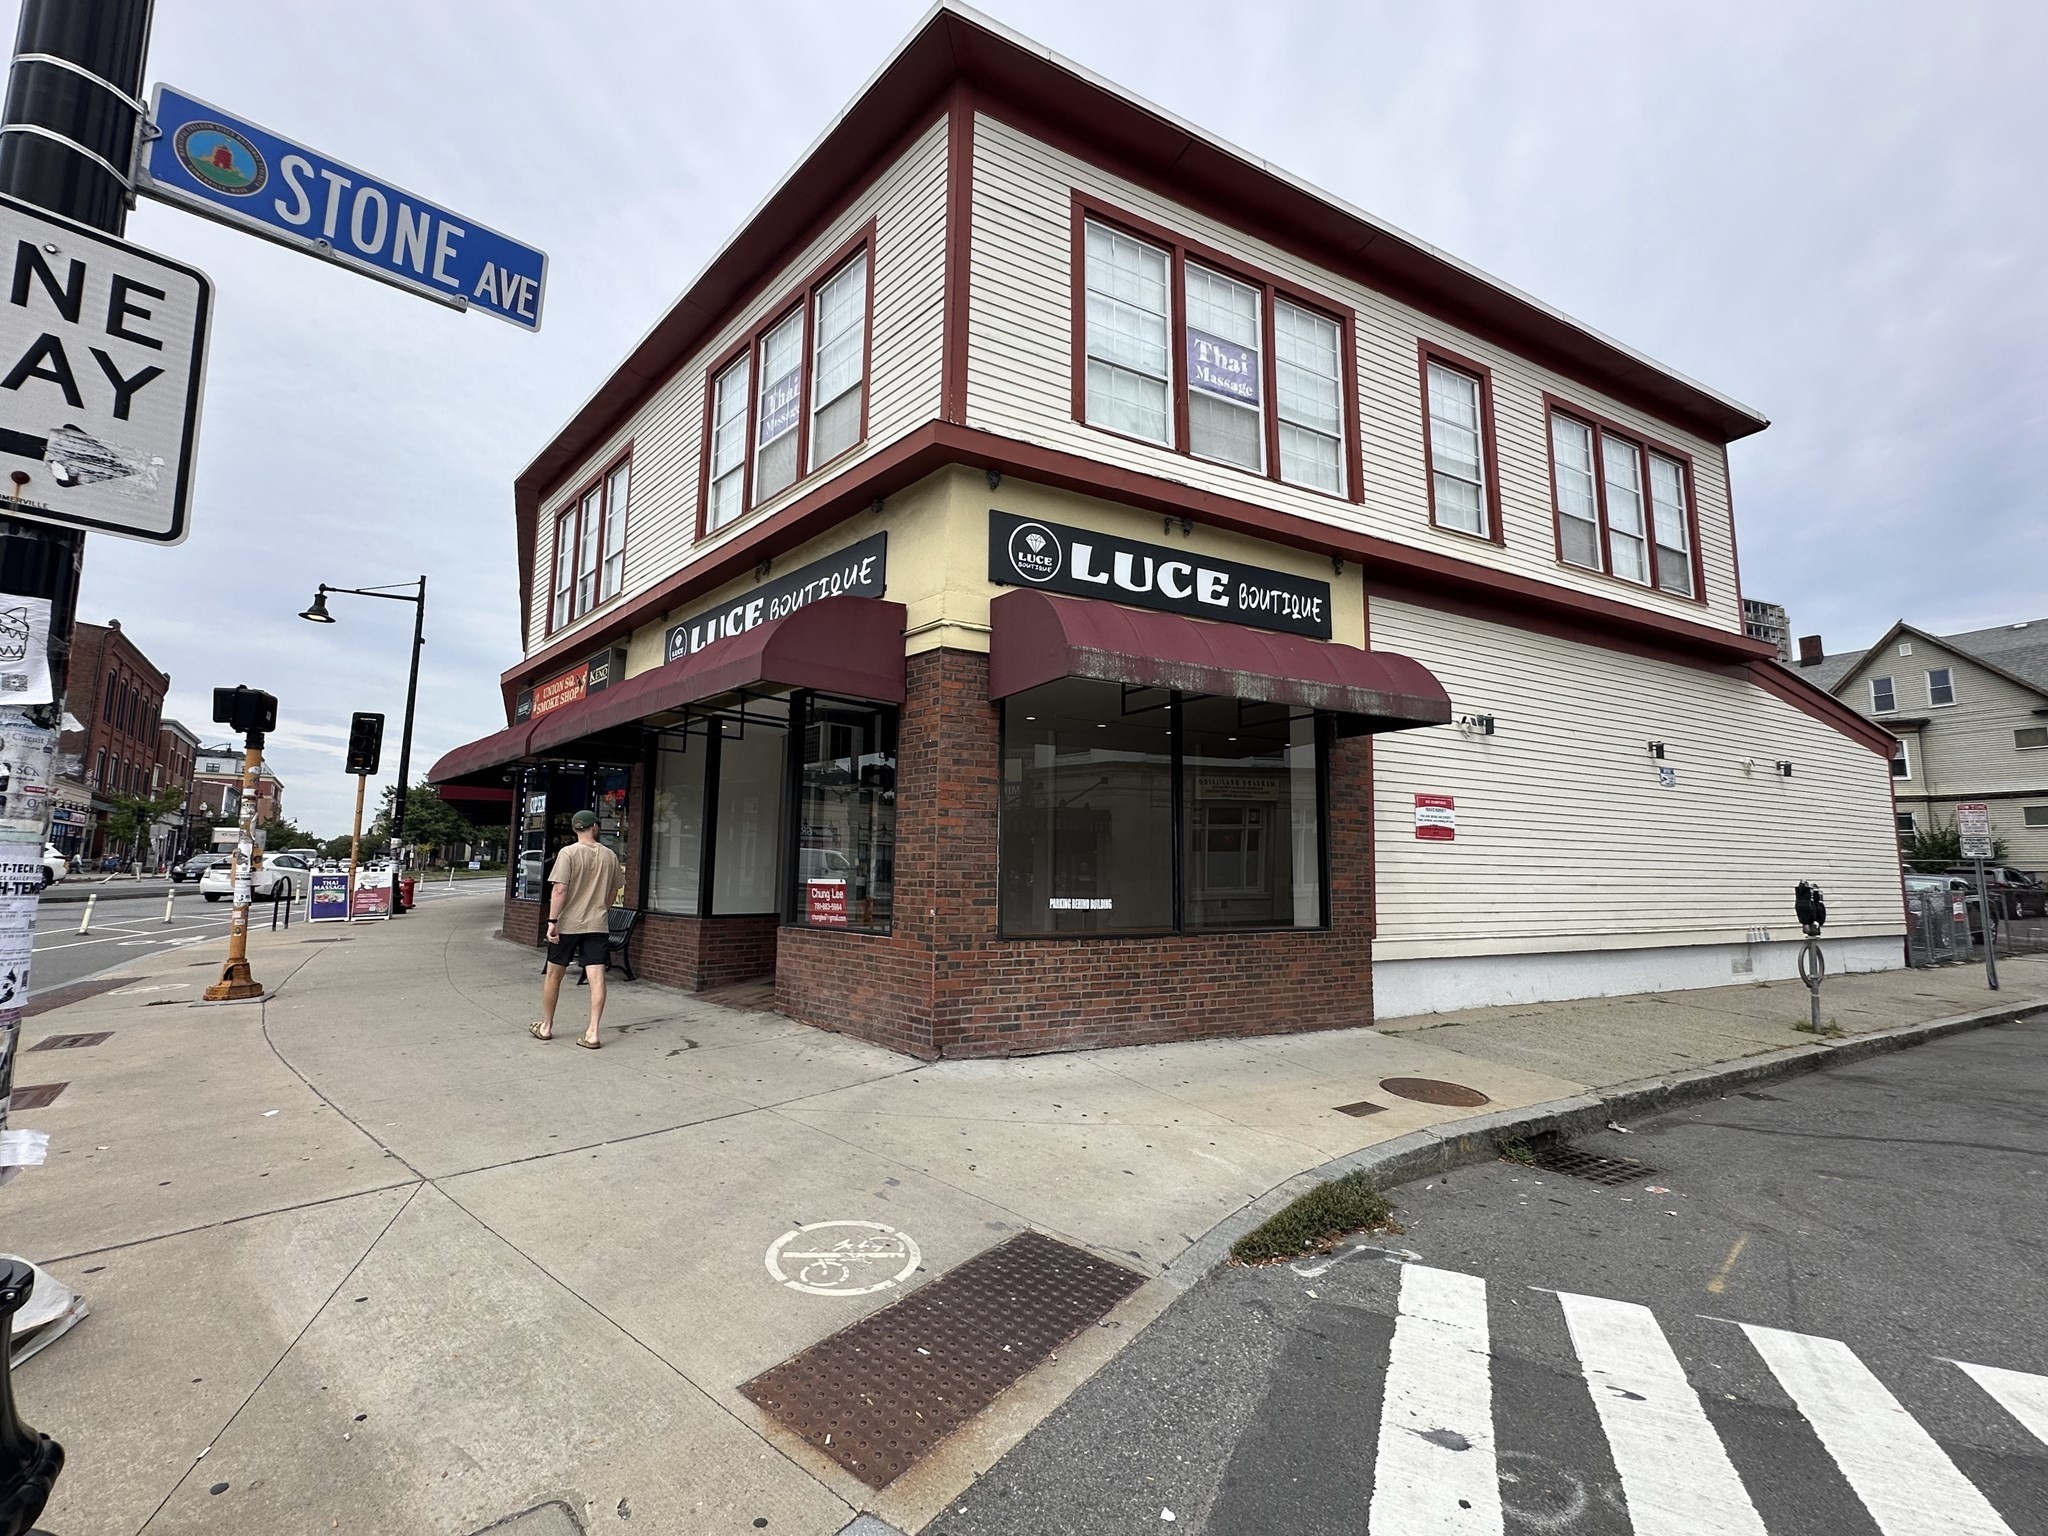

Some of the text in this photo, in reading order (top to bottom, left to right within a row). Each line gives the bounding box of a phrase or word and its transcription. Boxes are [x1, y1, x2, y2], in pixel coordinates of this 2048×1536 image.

[274, 155, 538, 320] STONE AVE
[10, 239, 166, 351] NE
[1194, 338, 1248, 376] Thai
[0, 333, 165, 421] AY
[1195, 364, 1253, 397] Massage
[768, 376, 799, 414] Thai
[0, 493, 49, 509] MERVILLE
[1018, 552, 1053, 566] LUCE
[1018, 561, 1052, 573] BOUTIQUE
[1071, 542, 1323, 623] LUCE BOUTIQUE
[691, 556, 876, 654] LUCE BOUTIQUE
[543, 680, 565, 699] UNION
[589, 667, 608, 682] KENO
[536, 695, 560, 715] SMOKE
[560, 686, 580, 705] SHOP
[812, 888, 844, 901] Chung Lee
[1049, 898, 1112, 910] PARKING BEHIND BUILDING
